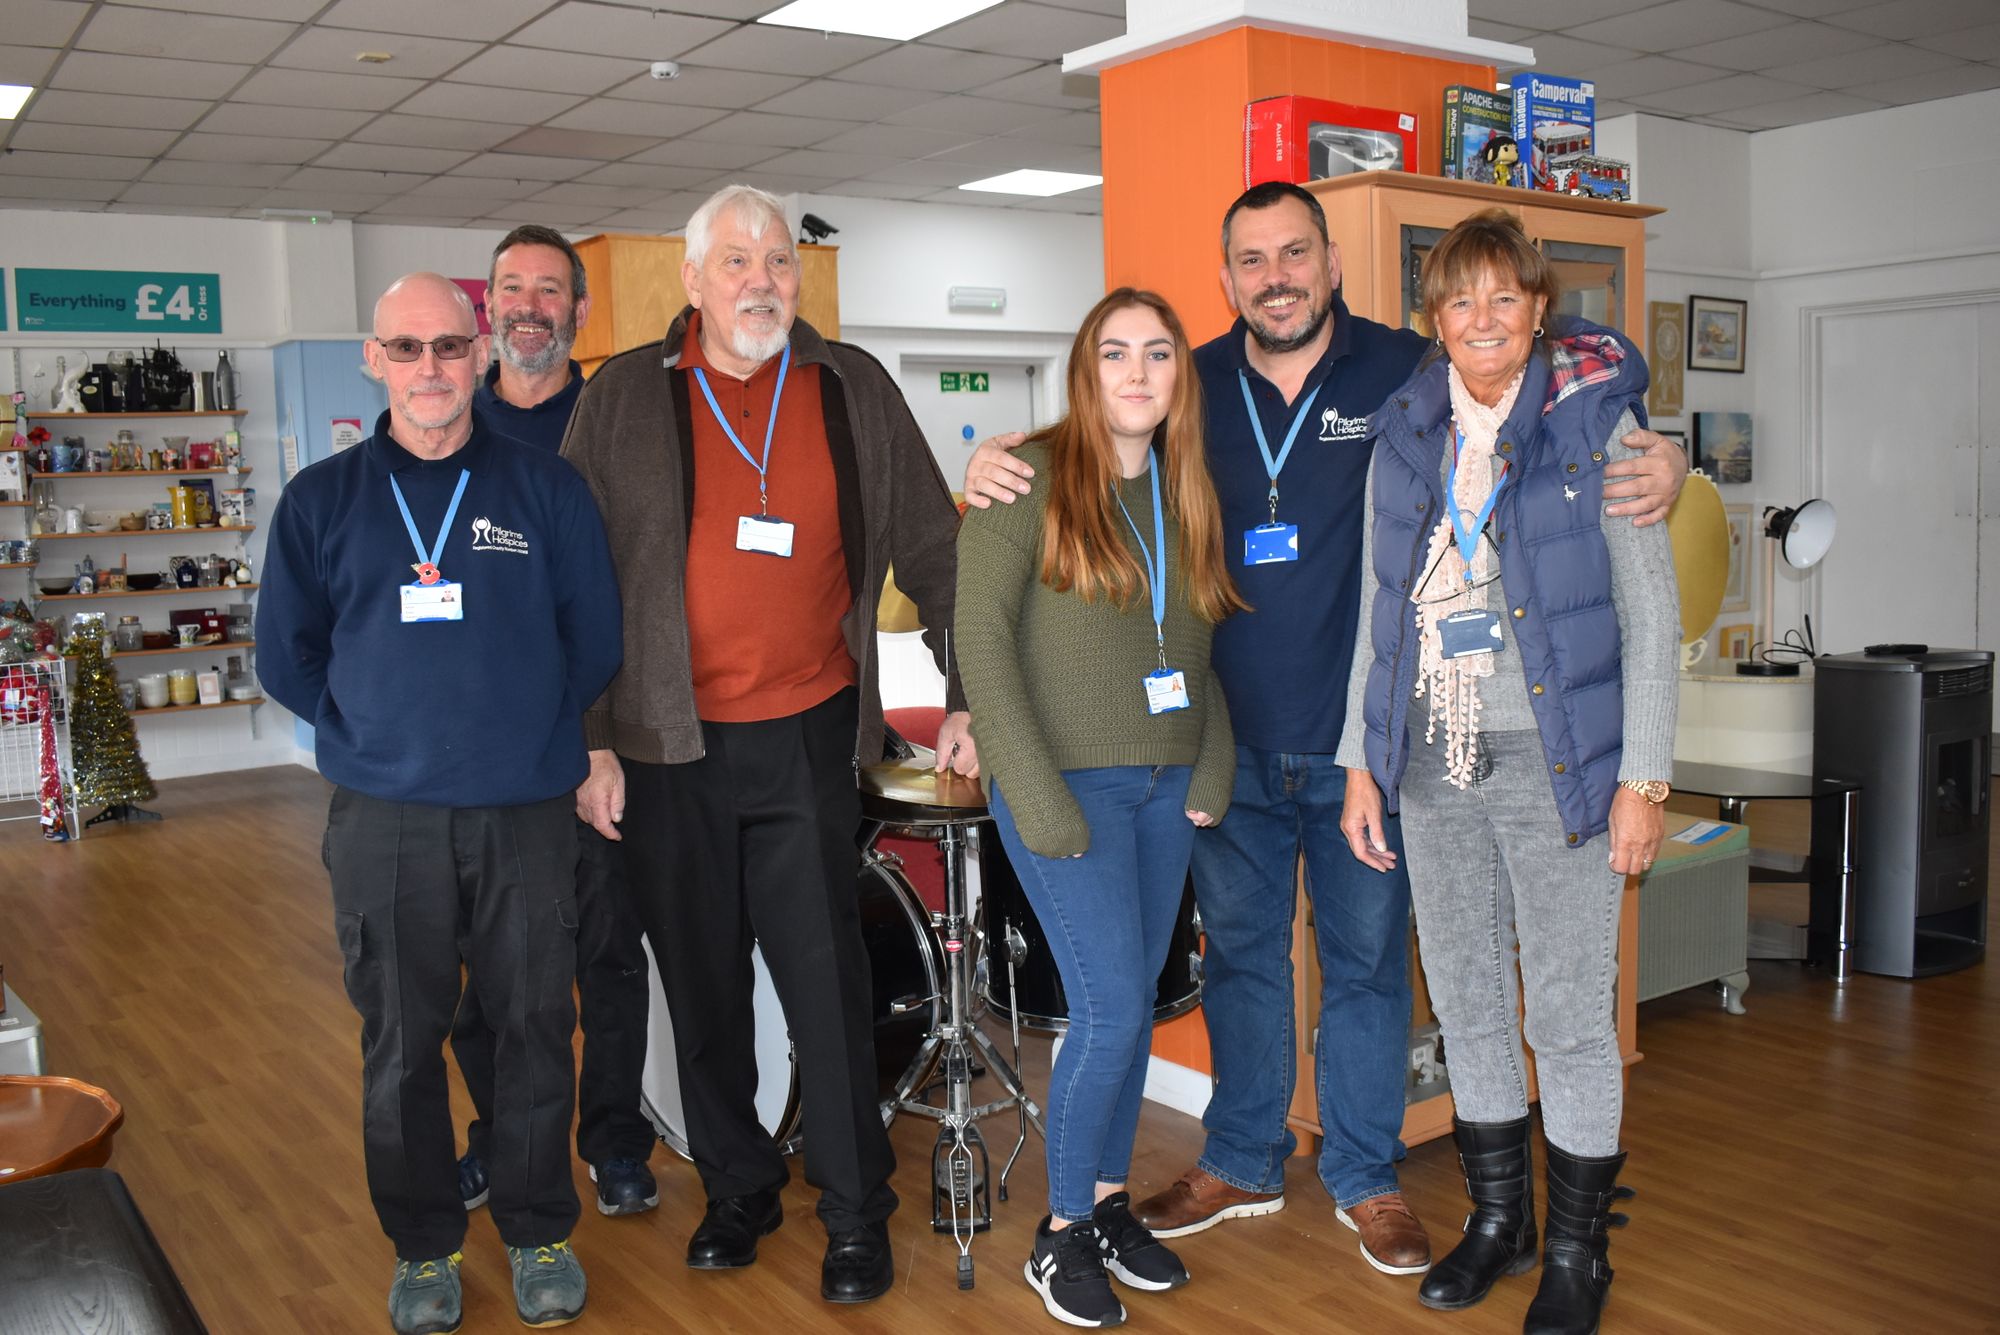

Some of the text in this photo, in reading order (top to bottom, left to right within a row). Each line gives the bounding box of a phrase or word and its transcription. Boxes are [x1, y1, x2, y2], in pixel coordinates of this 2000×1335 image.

[1462, 91, 1493, 109] APACHE
[1462, 105, 1502, 121] CONSTRUCTION
[1517, 87, 1528, 140] Campervan
[1276, 149, 1283, 161] R8
[29, 292, 126, 312] Everything
[135, 283, 195, 321] £4
[198, 286, 208, 321] Or less
[492, 526, 523, 540] Pilgrims
[492, 535, 529, 548] Hospices
